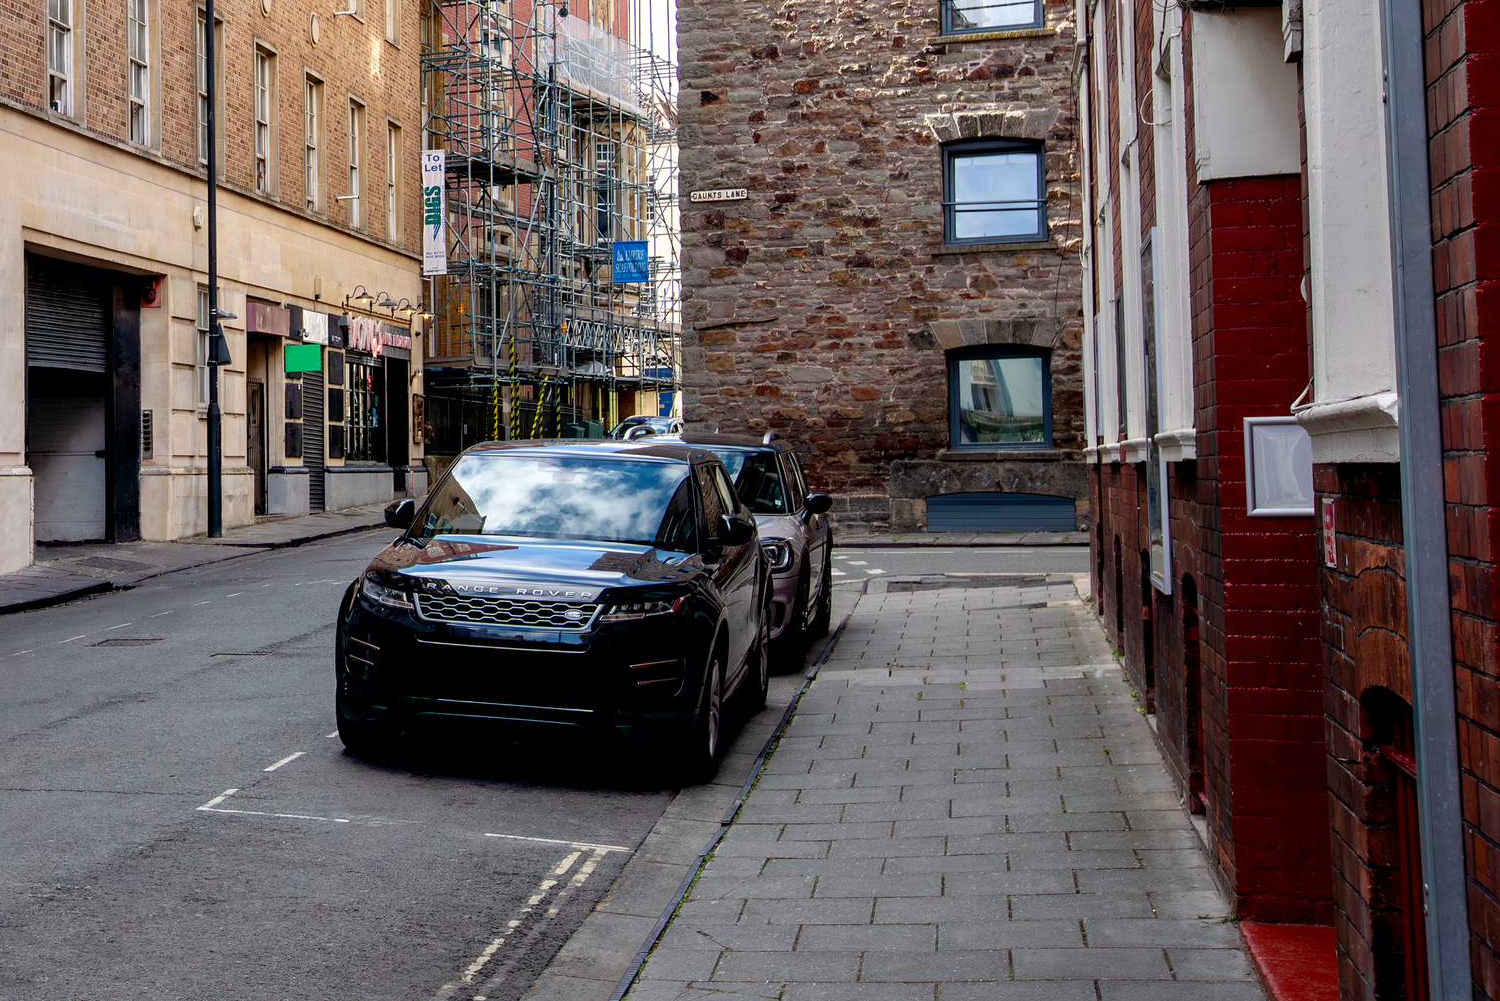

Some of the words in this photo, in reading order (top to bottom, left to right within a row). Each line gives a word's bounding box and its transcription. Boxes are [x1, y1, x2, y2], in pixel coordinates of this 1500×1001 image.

[426, 154, 440, 162] To
[424, 164, 442, 172] Let
[692, 191, 722, 200] GAUNTS
[725, 190, 746, 198] LANE
[424, 185, 441, 225] DIGS
[426, 582, 500, 594] RANGE
[516, 588, 593, 599] ROVER
